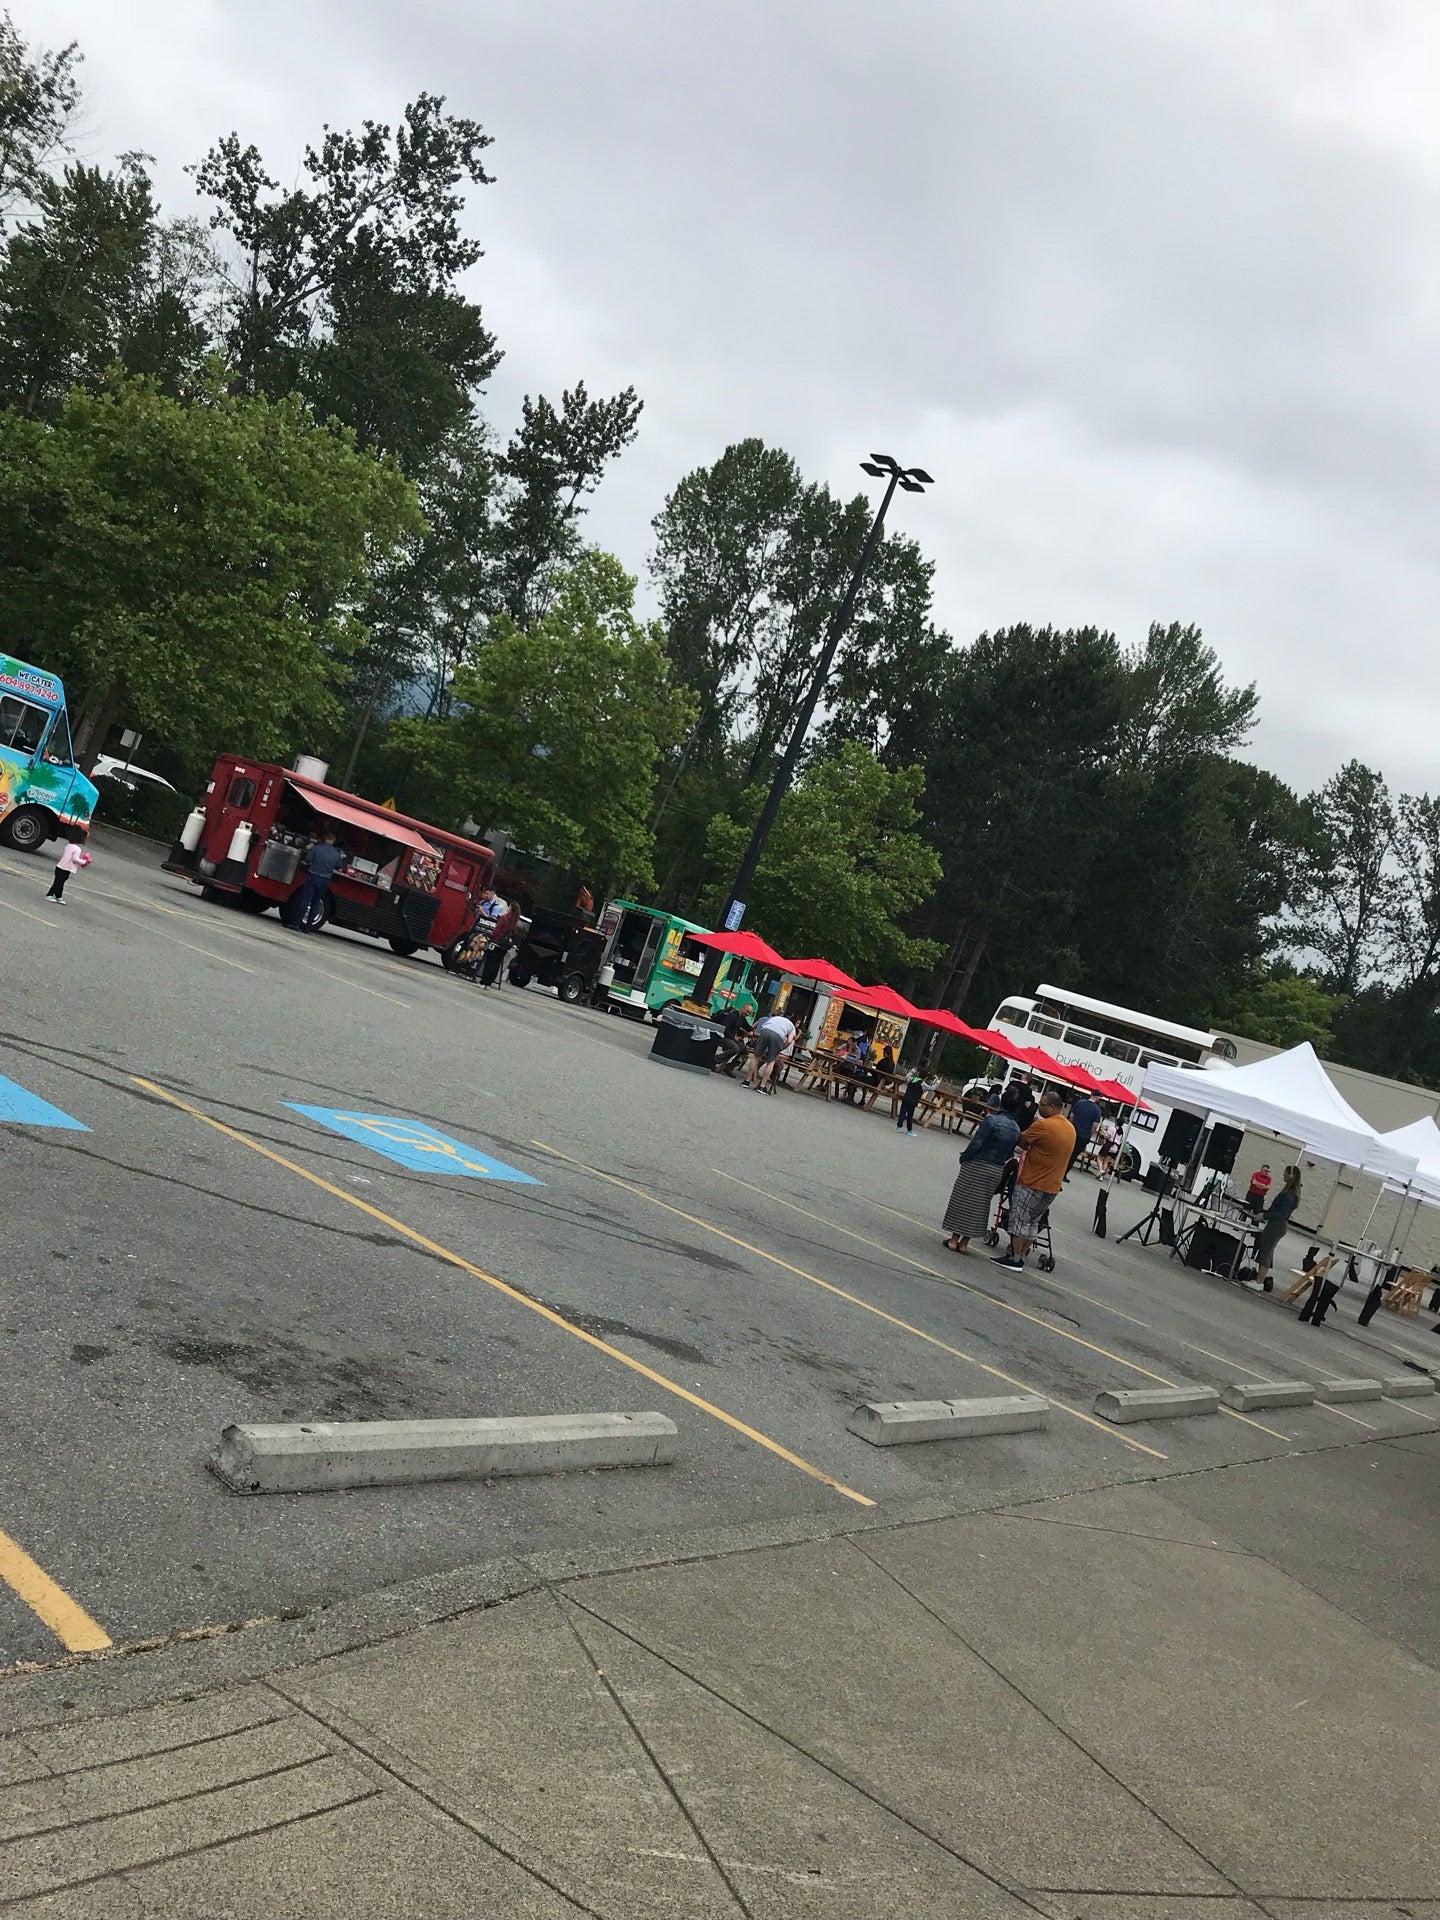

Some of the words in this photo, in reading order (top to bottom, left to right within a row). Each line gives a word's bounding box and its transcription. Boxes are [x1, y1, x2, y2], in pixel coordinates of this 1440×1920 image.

[19, 670, 30, 680] WE
[31, 675, 56, 688] CATER!
[1056, 1051, 1103, 1076] buddha
[1115, 1071, 1135, 1086] full
